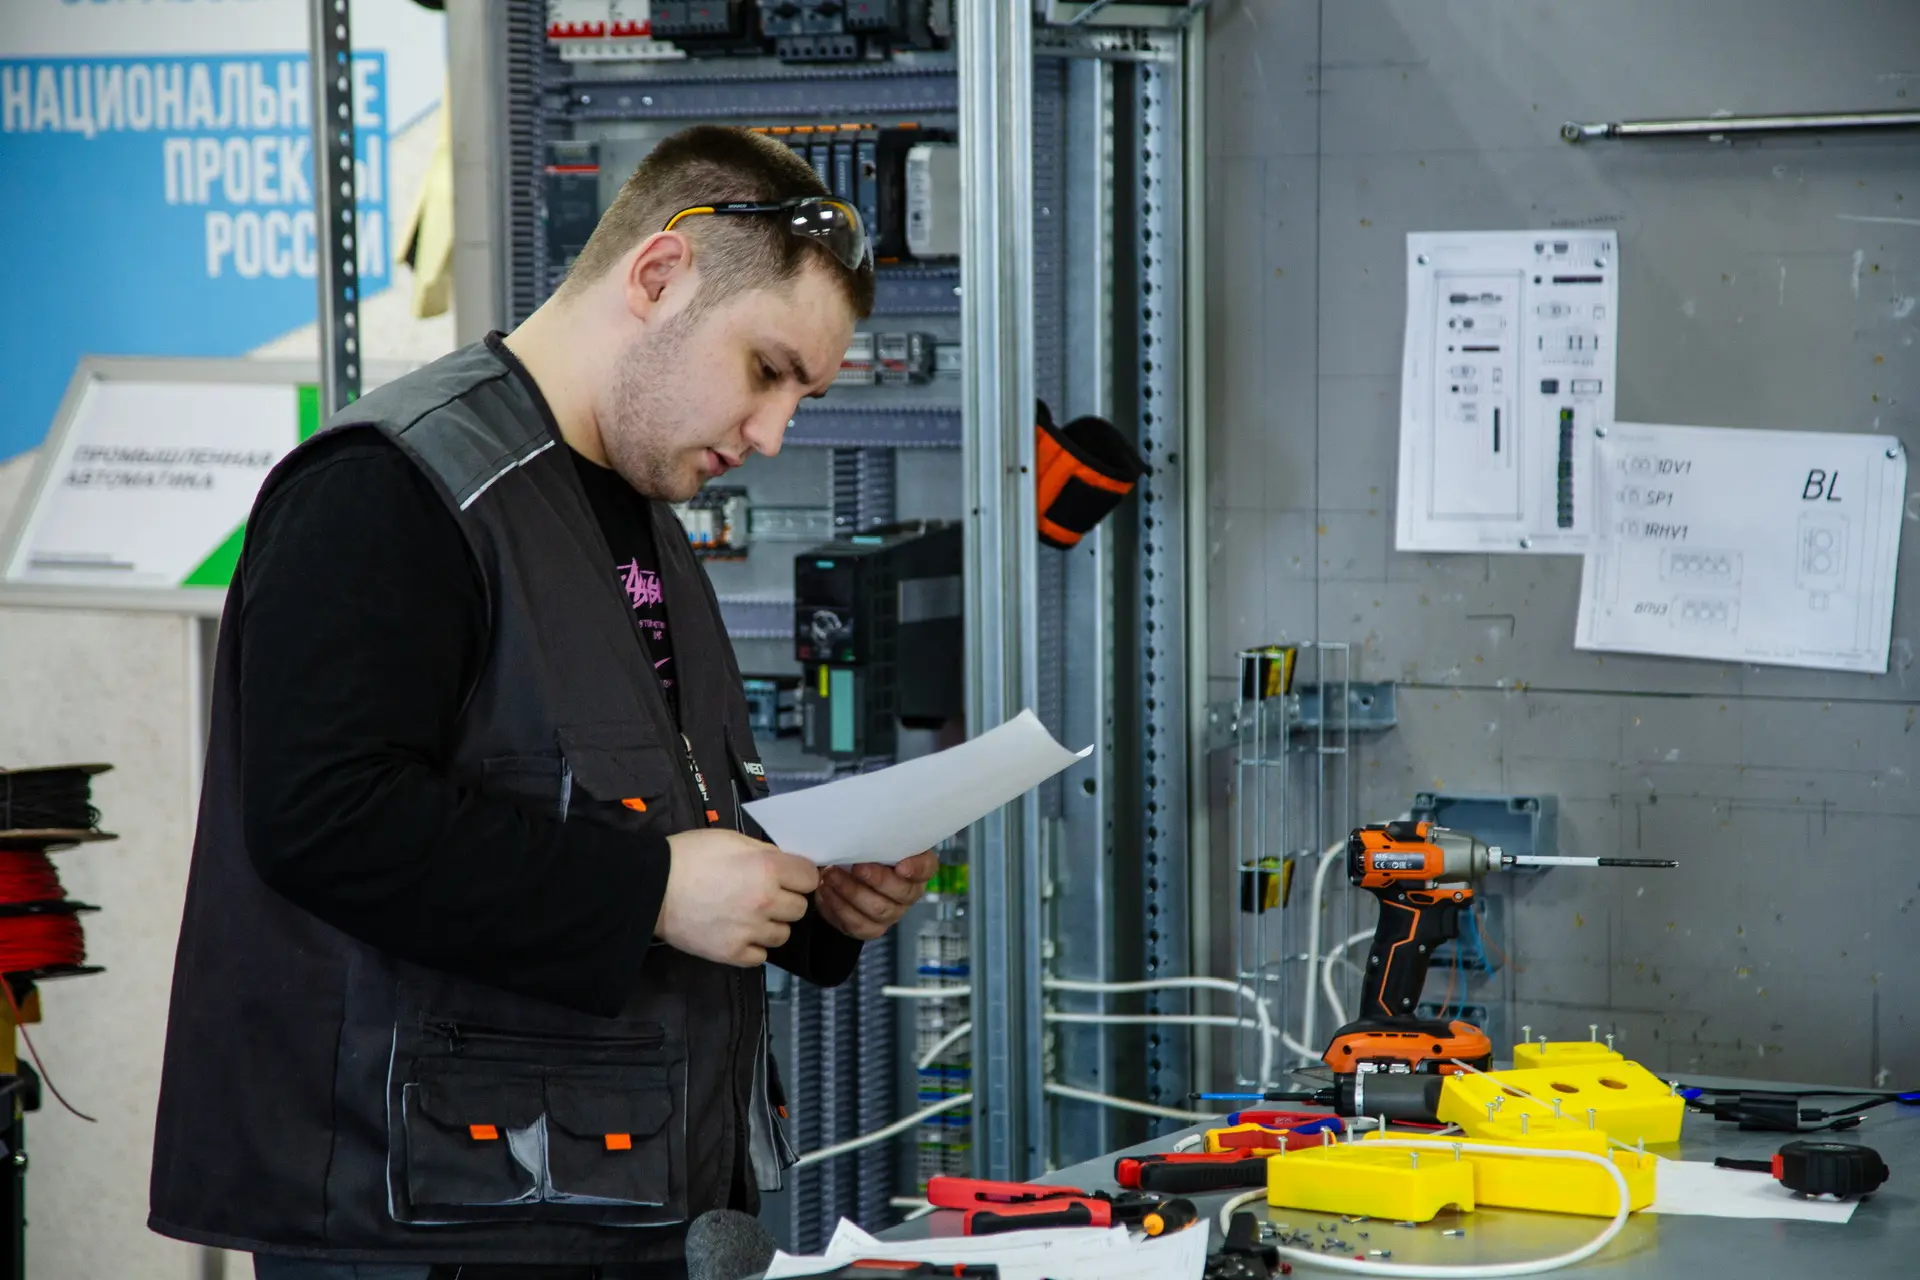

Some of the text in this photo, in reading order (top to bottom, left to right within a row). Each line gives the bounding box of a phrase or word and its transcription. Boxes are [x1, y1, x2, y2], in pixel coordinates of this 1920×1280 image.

[2, 60, 382, 140] НАЦИОНАЛЬНЕ
[163, 135, 382, 206] ПРОЕКЫ
[206, 210, 384, 279] РОССИ
[1801, 468, 1843, 502] BL
